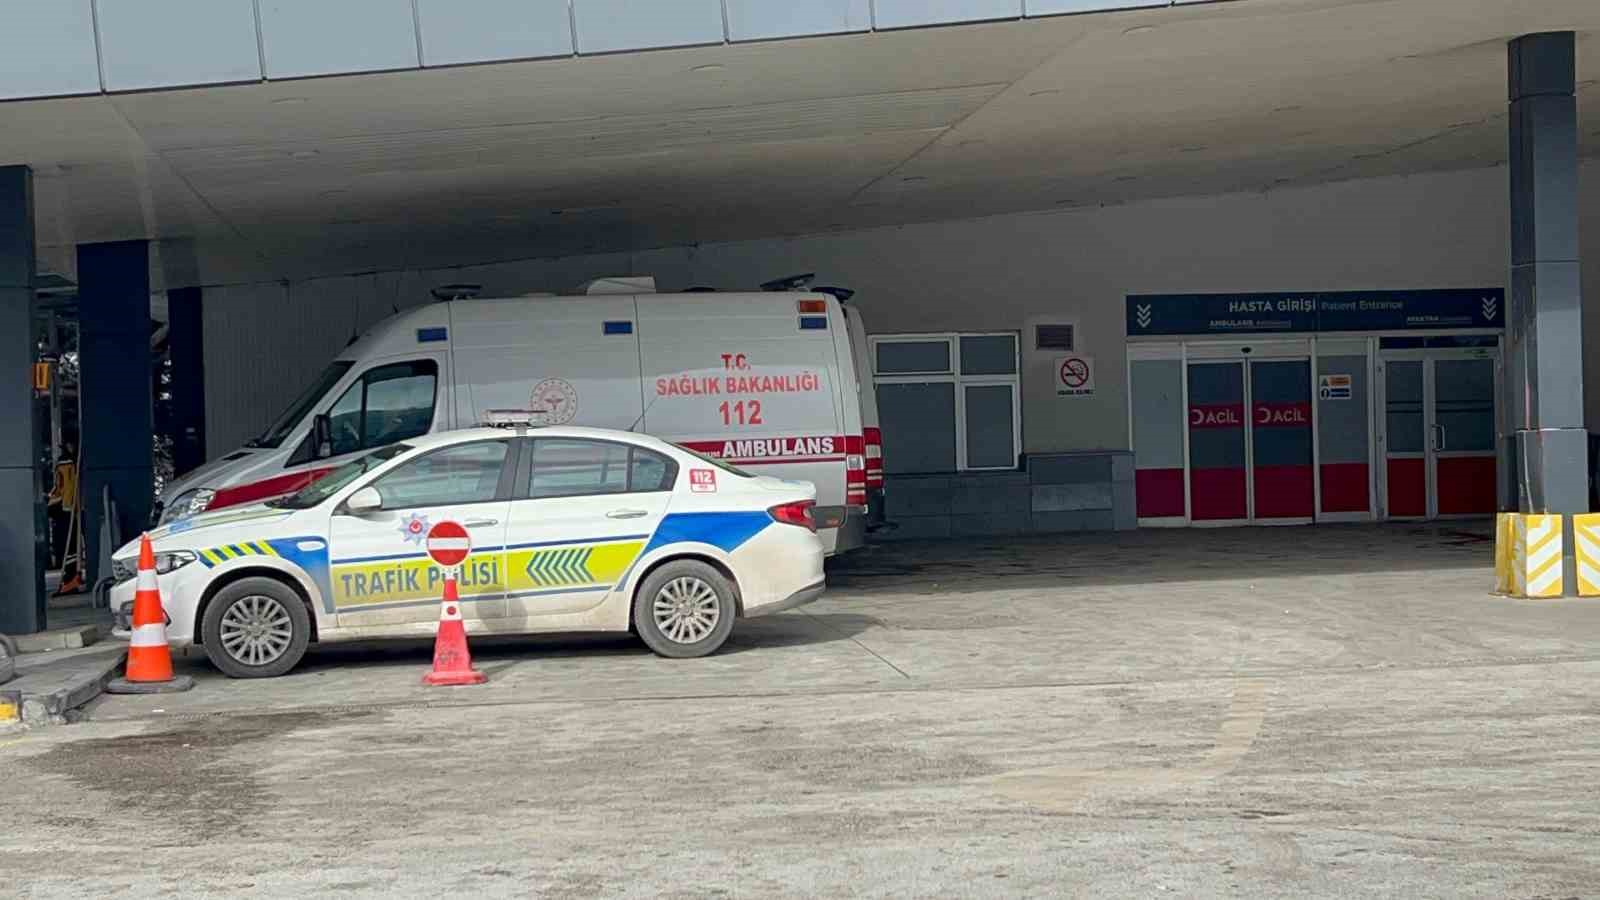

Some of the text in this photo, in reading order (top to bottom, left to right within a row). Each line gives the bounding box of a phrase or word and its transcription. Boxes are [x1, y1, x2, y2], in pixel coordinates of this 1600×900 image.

[1229, 300, 1273, 313] HASTA
[1277, 297, 1317, 313] GİRİŞİ
[720, 353, 752, 370] T.C.
[656, 371, 819, 396] SAĞLIK BAKANLIĞI
[719, 400, 763, 425] 112
[1205, 408, 1240, 424] ACİL
[1273, 407, 1306, 423] ACİL
[722, 437, 834, 458] AMBULANS
[692, 469, 713, 482] 112
[342, 564, 420, 597] TRAFİK
